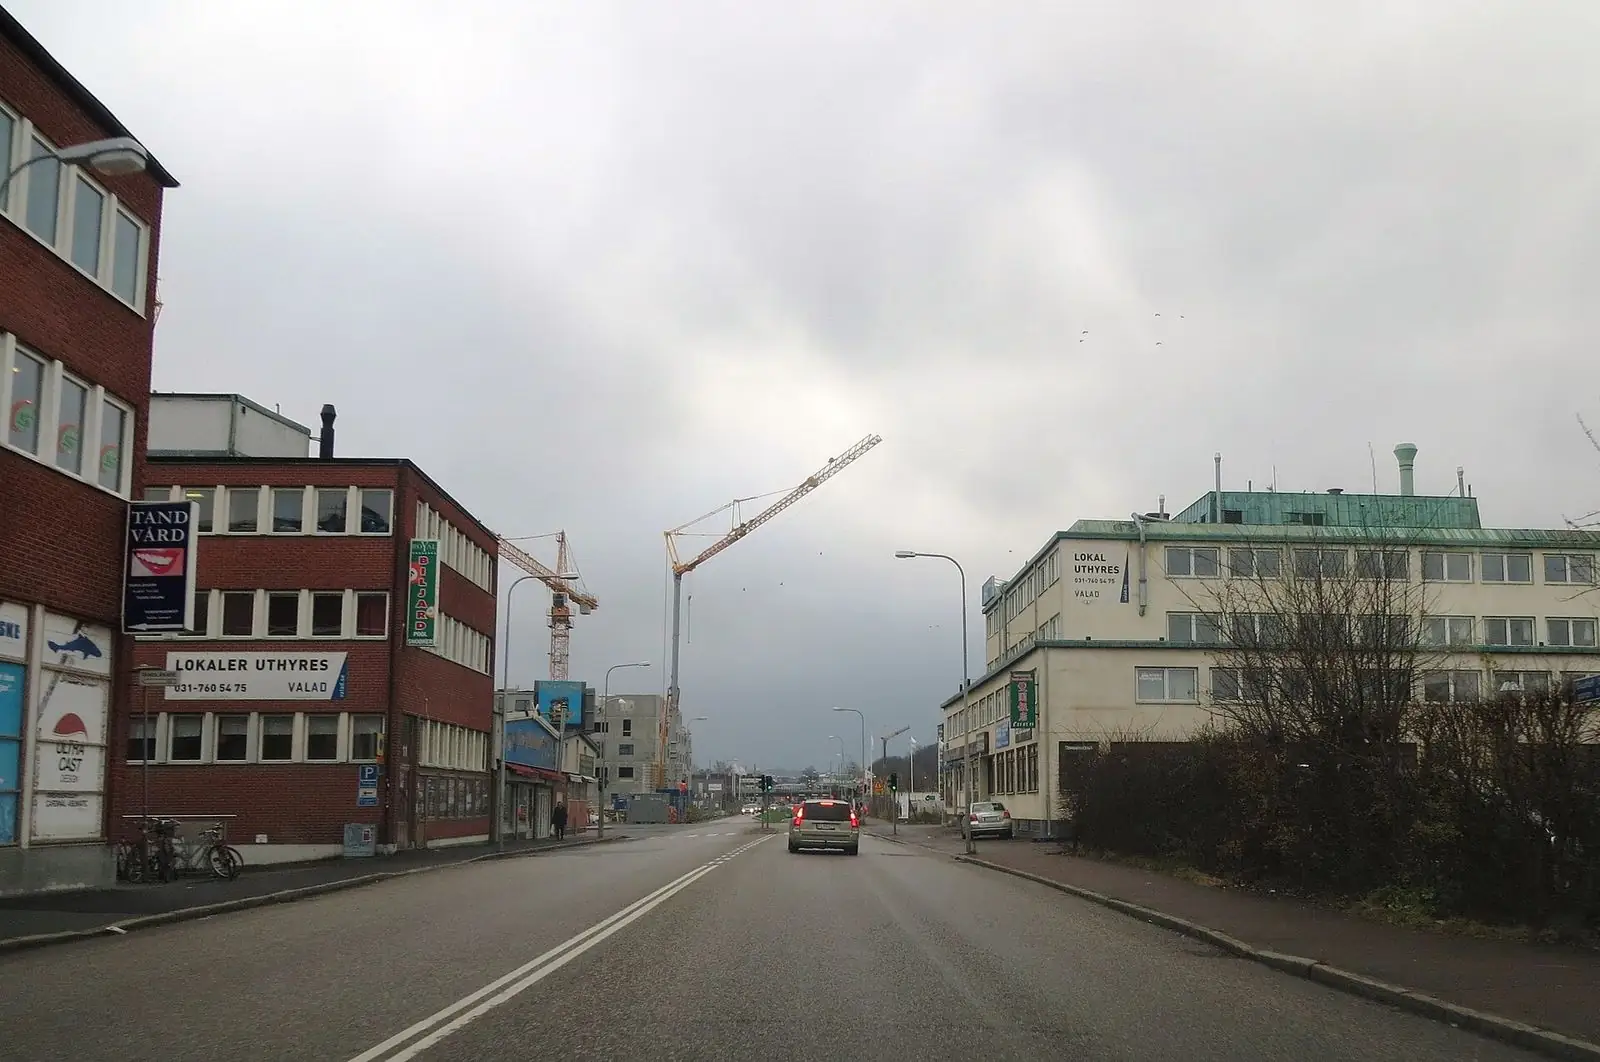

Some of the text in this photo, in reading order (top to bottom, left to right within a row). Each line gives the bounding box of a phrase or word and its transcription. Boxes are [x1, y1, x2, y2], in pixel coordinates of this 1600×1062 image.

[132, 511, 188, 524] TAND
[132, 527, 185, 542] VÅRD
[1074, 553, 1106, 562] LOKAL
[1074, 565, 1120, 574] UTHYRES
[415, 555, 429, 631] BILJARD
[1074, 590, 1100, 598] VALAD
[175, 659, 329, 671] LOKALER UTHYRES
[174, 682, 327, 693] 031-760 54 75 VALAD
[58, 757, 83, 772] CAST
[364, 766, 374, 779] P
